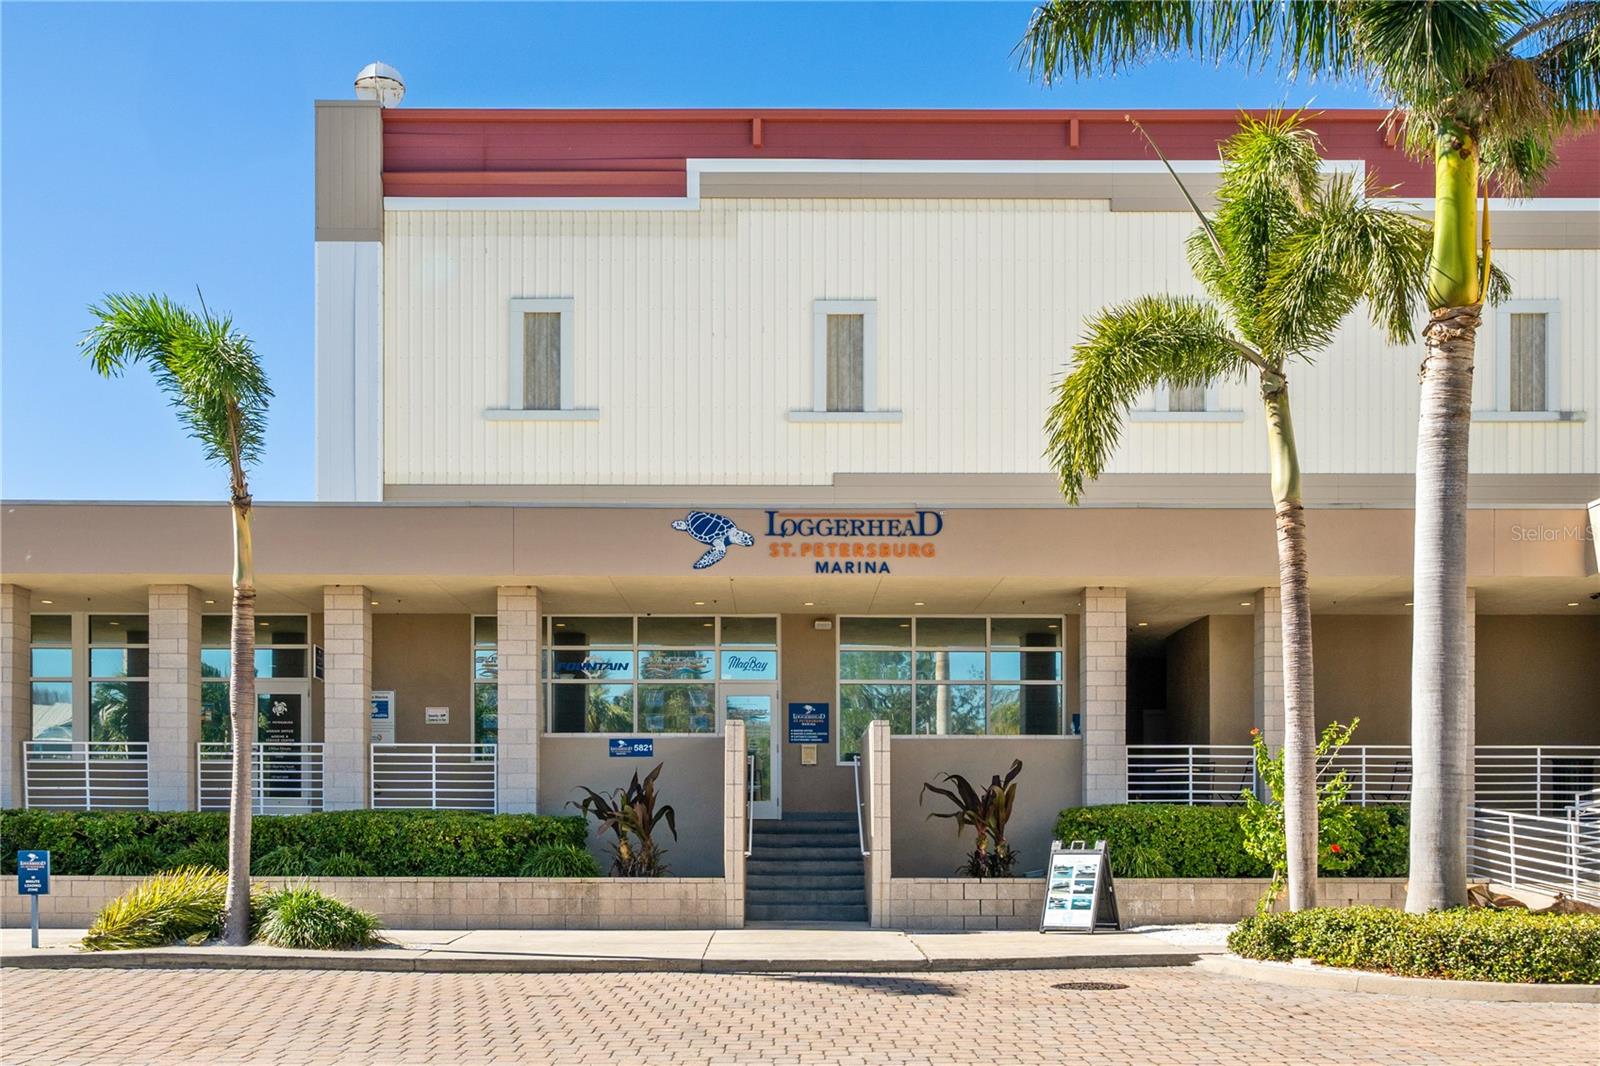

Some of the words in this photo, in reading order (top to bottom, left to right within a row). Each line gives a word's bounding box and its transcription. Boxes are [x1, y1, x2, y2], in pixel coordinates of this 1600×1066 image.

[764, 510, 943, 538] LOGGERHEAD
[769, 542, 797, 558] ST.
[800, 542, 936, 558] PETERSBURG
[815, 561, 891, 574] MARINA
